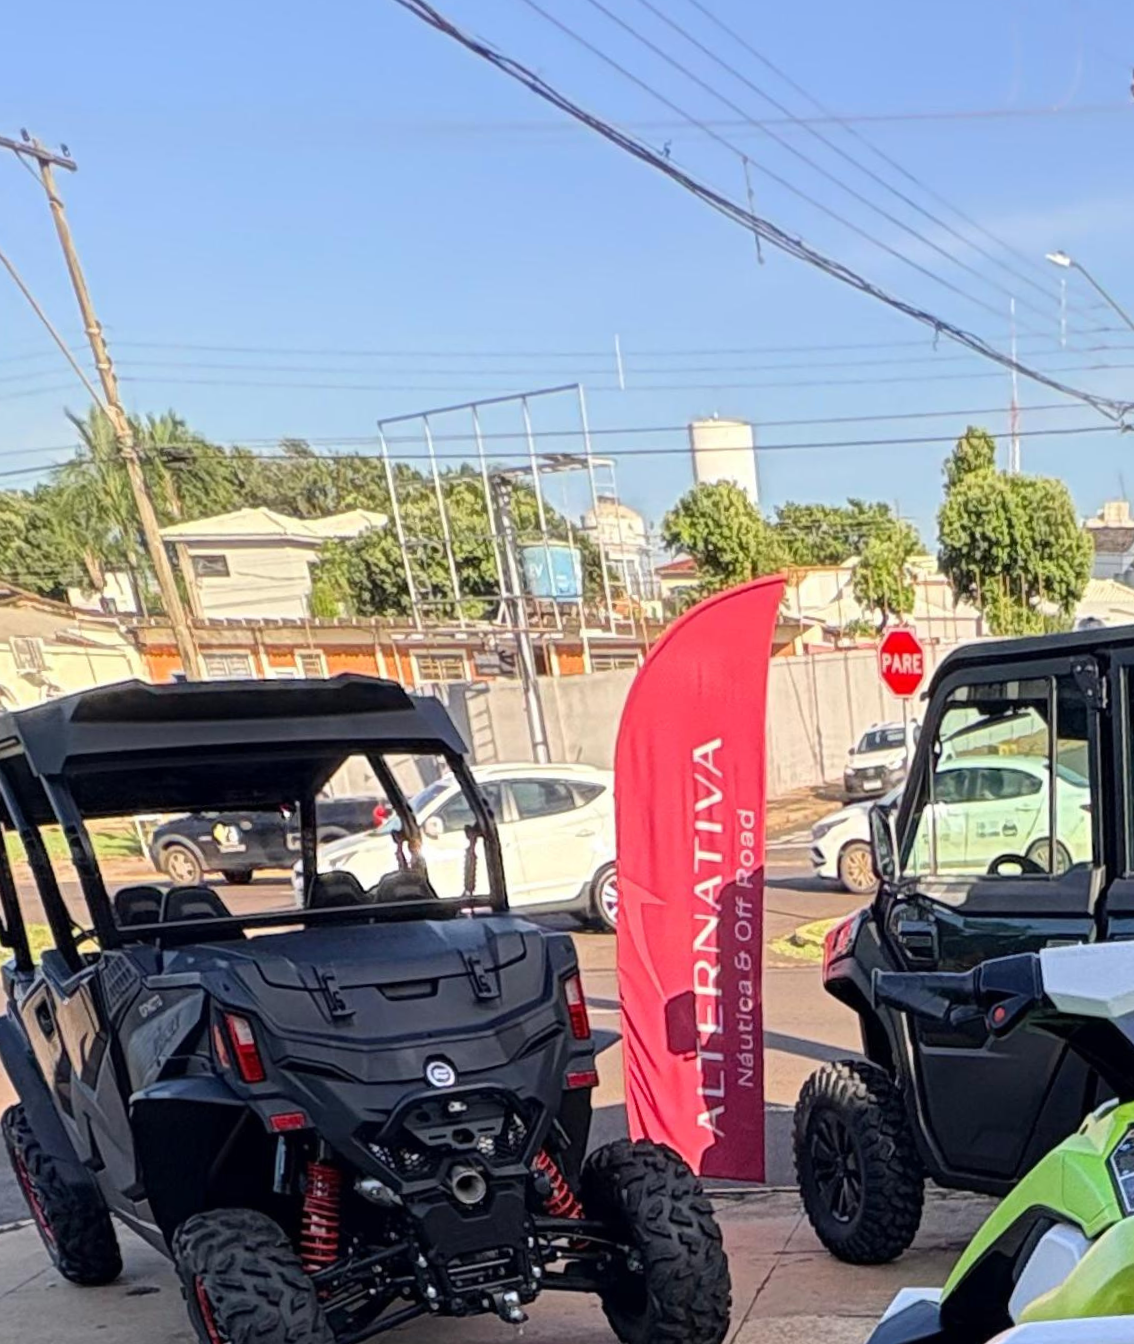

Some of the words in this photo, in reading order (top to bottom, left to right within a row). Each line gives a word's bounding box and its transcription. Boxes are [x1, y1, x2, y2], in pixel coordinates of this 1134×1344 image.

[881, 652, 922, 675] PARE
[736, 808, 756, 888] Road
[691, 737, 726, 1138] ALTERNATIVA
[734, 896, 753, 942] Off
[733, 950, 752, 971] &
[735, 981, 755, 1088] Náutica
